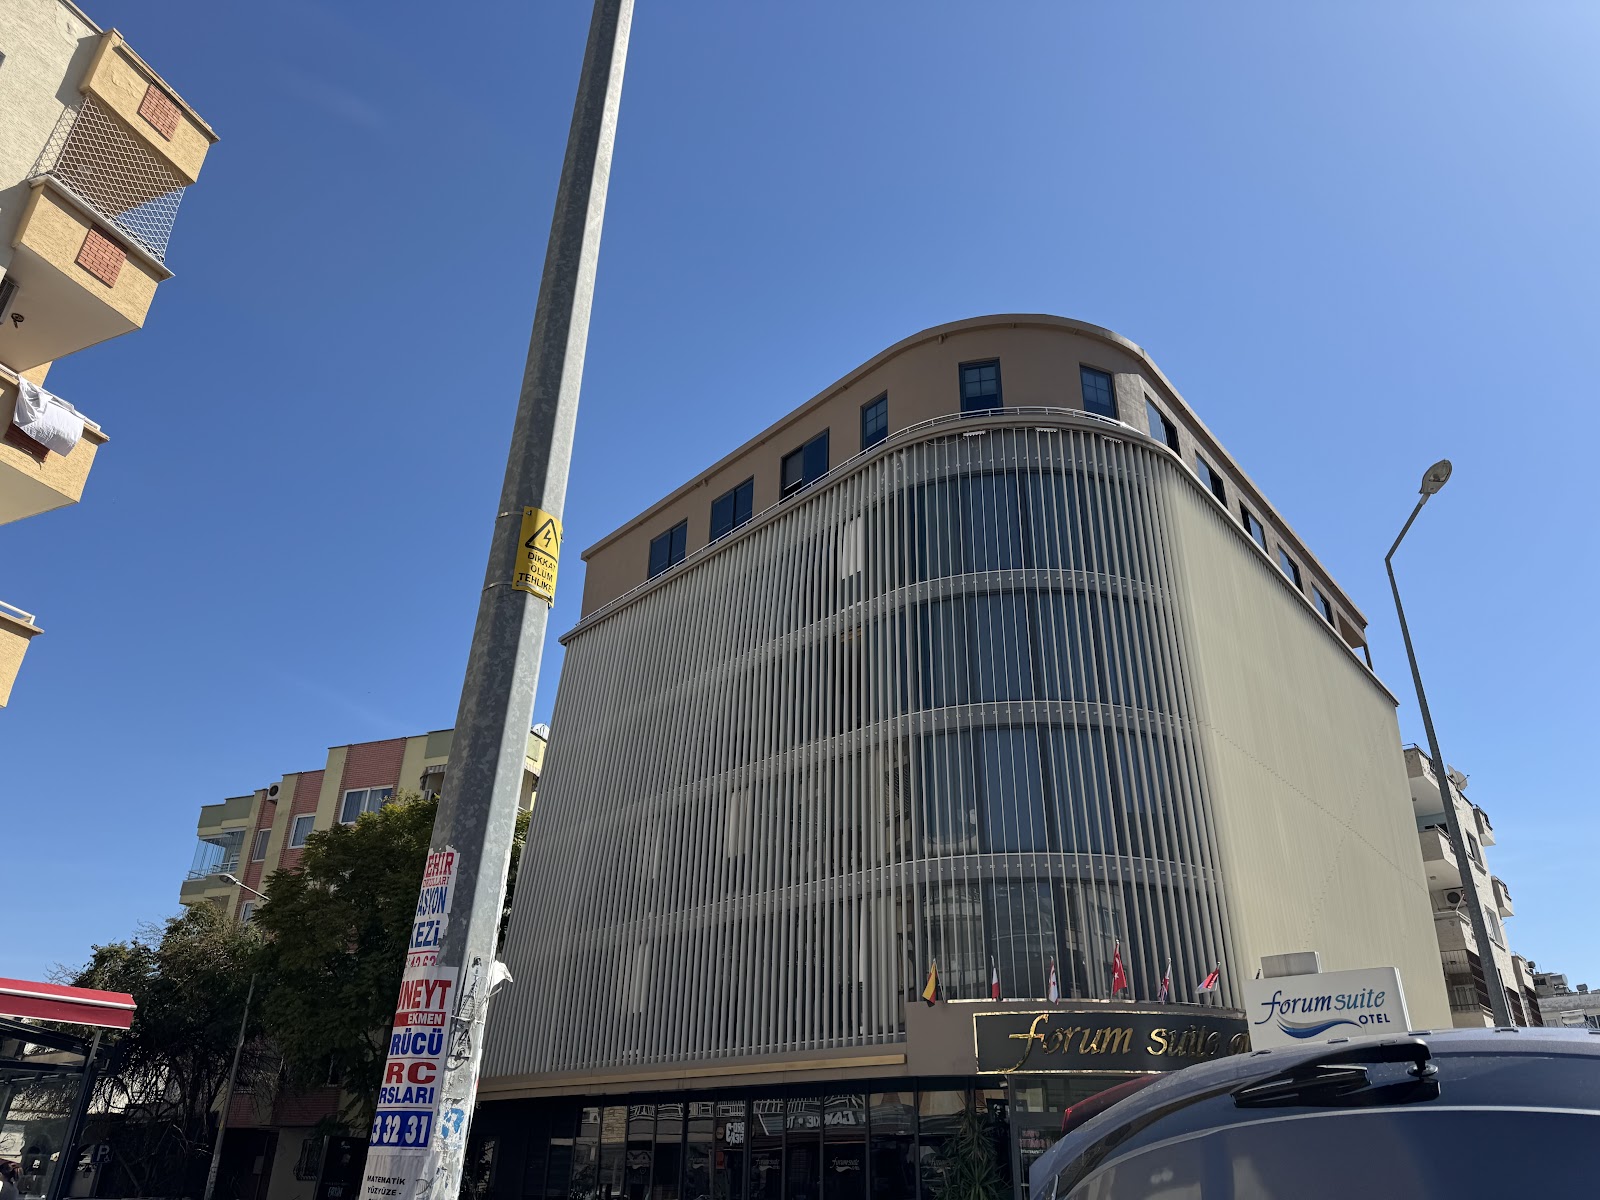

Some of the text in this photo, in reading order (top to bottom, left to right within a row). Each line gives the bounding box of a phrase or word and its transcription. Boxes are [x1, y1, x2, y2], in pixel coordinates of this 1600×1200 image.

[518, 572, 554, 595] TEHLİKE
[530, 562, 553, 583] ÖLÜM
[417, 886, 448, 916] ASYON
[407, 1012, 443, 1025] EKMEN
[1358, 1013, 1391, 1025] OTEL
[390, 1027, 444, 1056] RÜCÜ
[1001, 1013, 1134, 1074] forum
[1146, 1024, 1222, 1056] suite
[385, 1061, 437, 1085] RC
[379, 1086, 435, 1104] RSLARI
[370, 1115, 383, 1144] 3
[404, 1115, 429, 1144] 31
[366, 1175, 406, 1185] MATEMATİK
